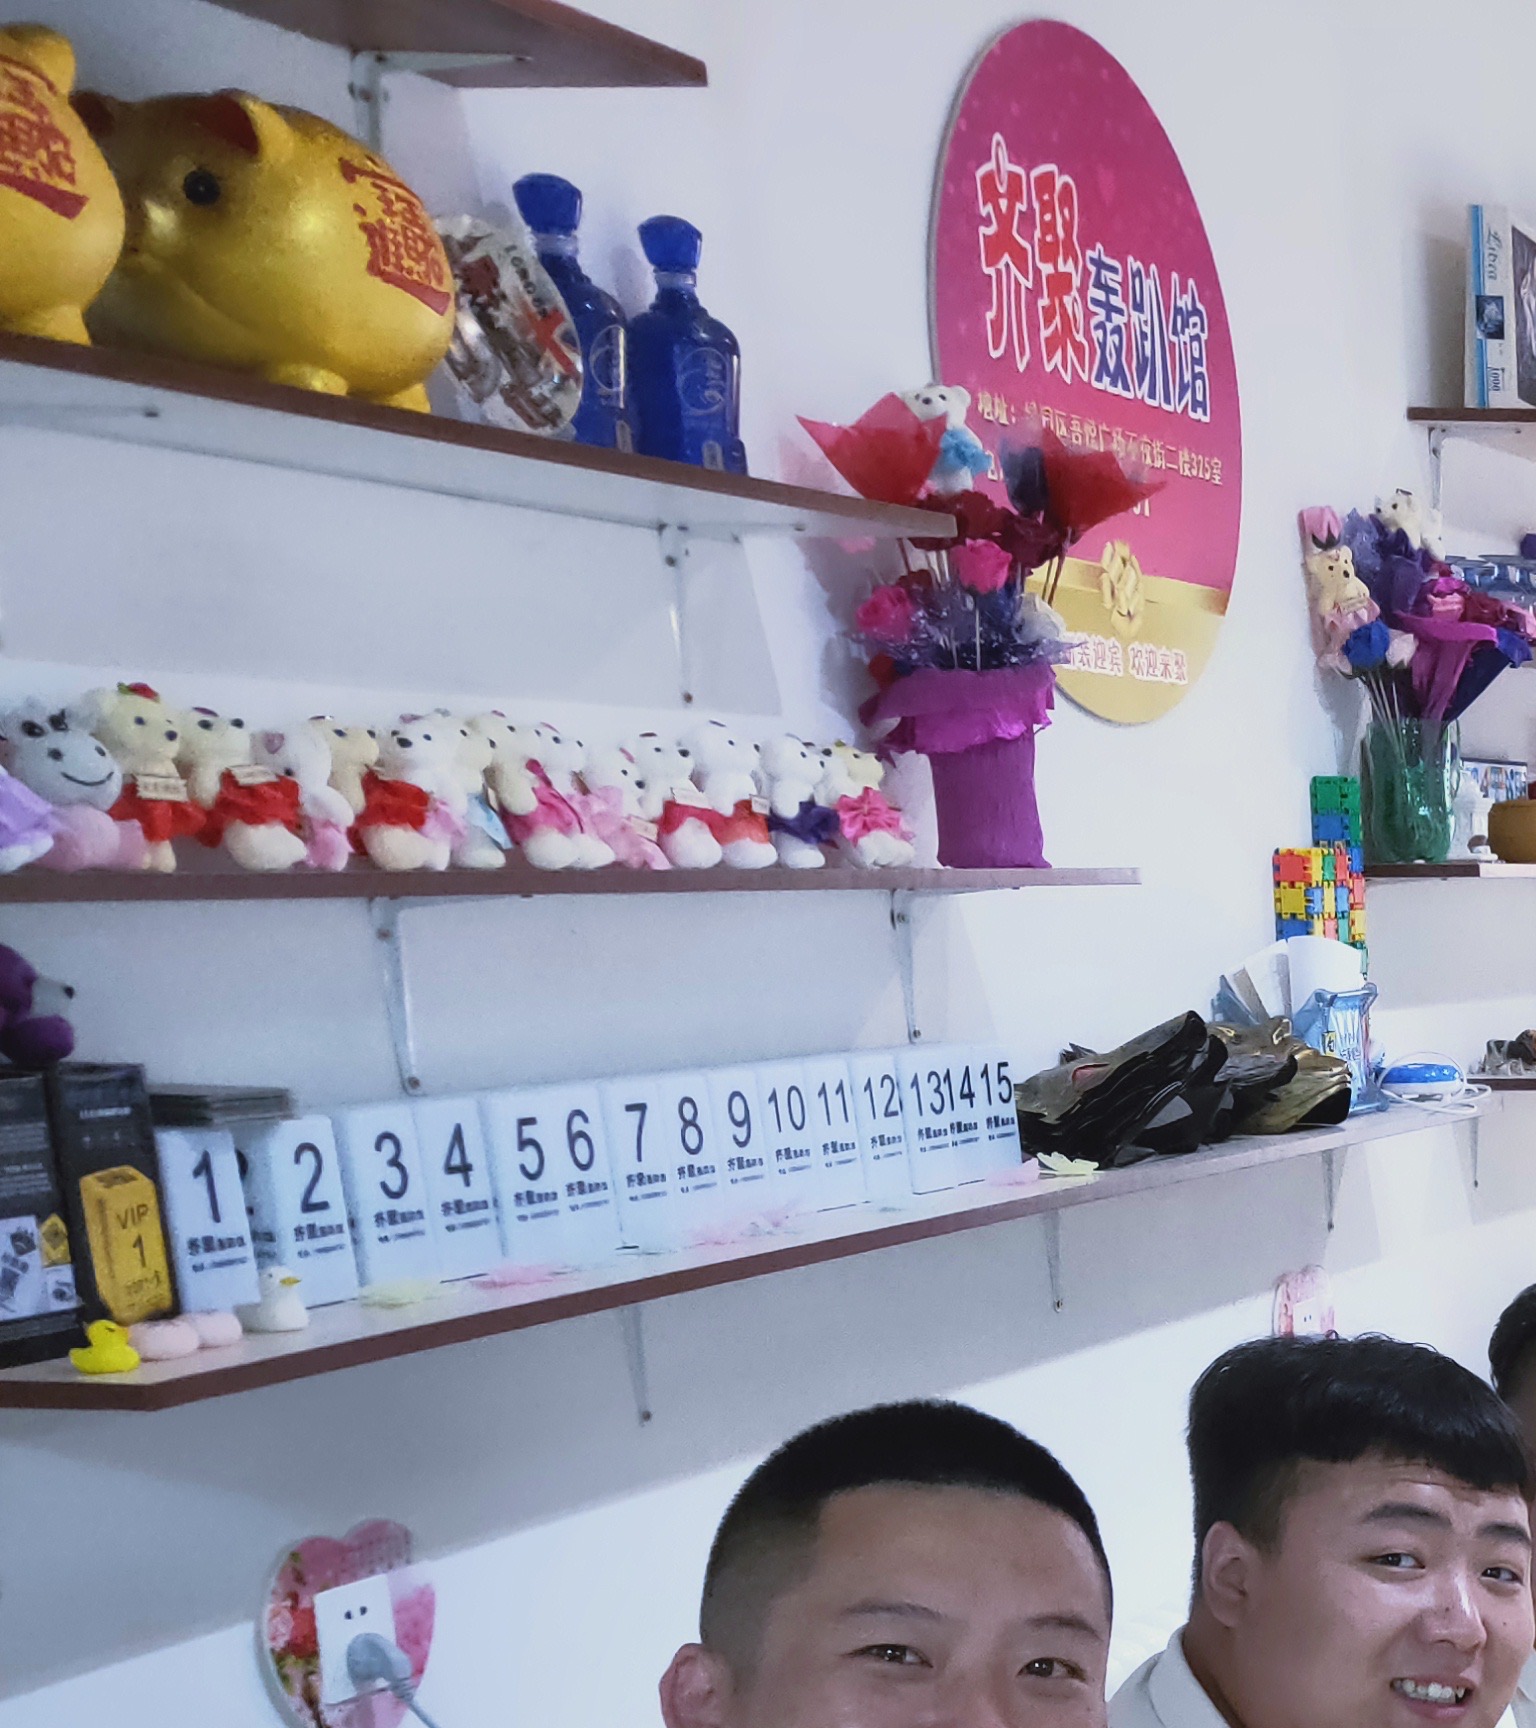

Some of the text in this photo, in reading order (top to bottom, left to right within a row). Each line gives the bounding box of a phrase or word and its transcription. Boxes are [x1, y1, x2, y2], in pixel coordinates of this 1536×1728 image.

[768, 1085, 805, 1134] 10
[817, 1079, 849, 1126] 11
[864, 1074, 899, 1120] 12
[910, 1070, 945, 1117] 13
[943, 1065, 976, 1112] 14
[980, 1061, 1013, 1105] 15
[567, 1109, 595, 1172] 6
[625, 1102, 647, 1163] 7
[678, 1096, 704, 1156] 8
[728, 1090, 751, 1148] 9
[294, 1142, 331, 1214] 2
[375, 1131, 409, 1200] 3
[444, 1123, 473, 1188] 4
[517, 1117, 545, 1182] 5
[193, 1150, 222, 1224] 1
[116, 1204, 149, 1230] VIP
[132, 1235, 147, 1268] 1
